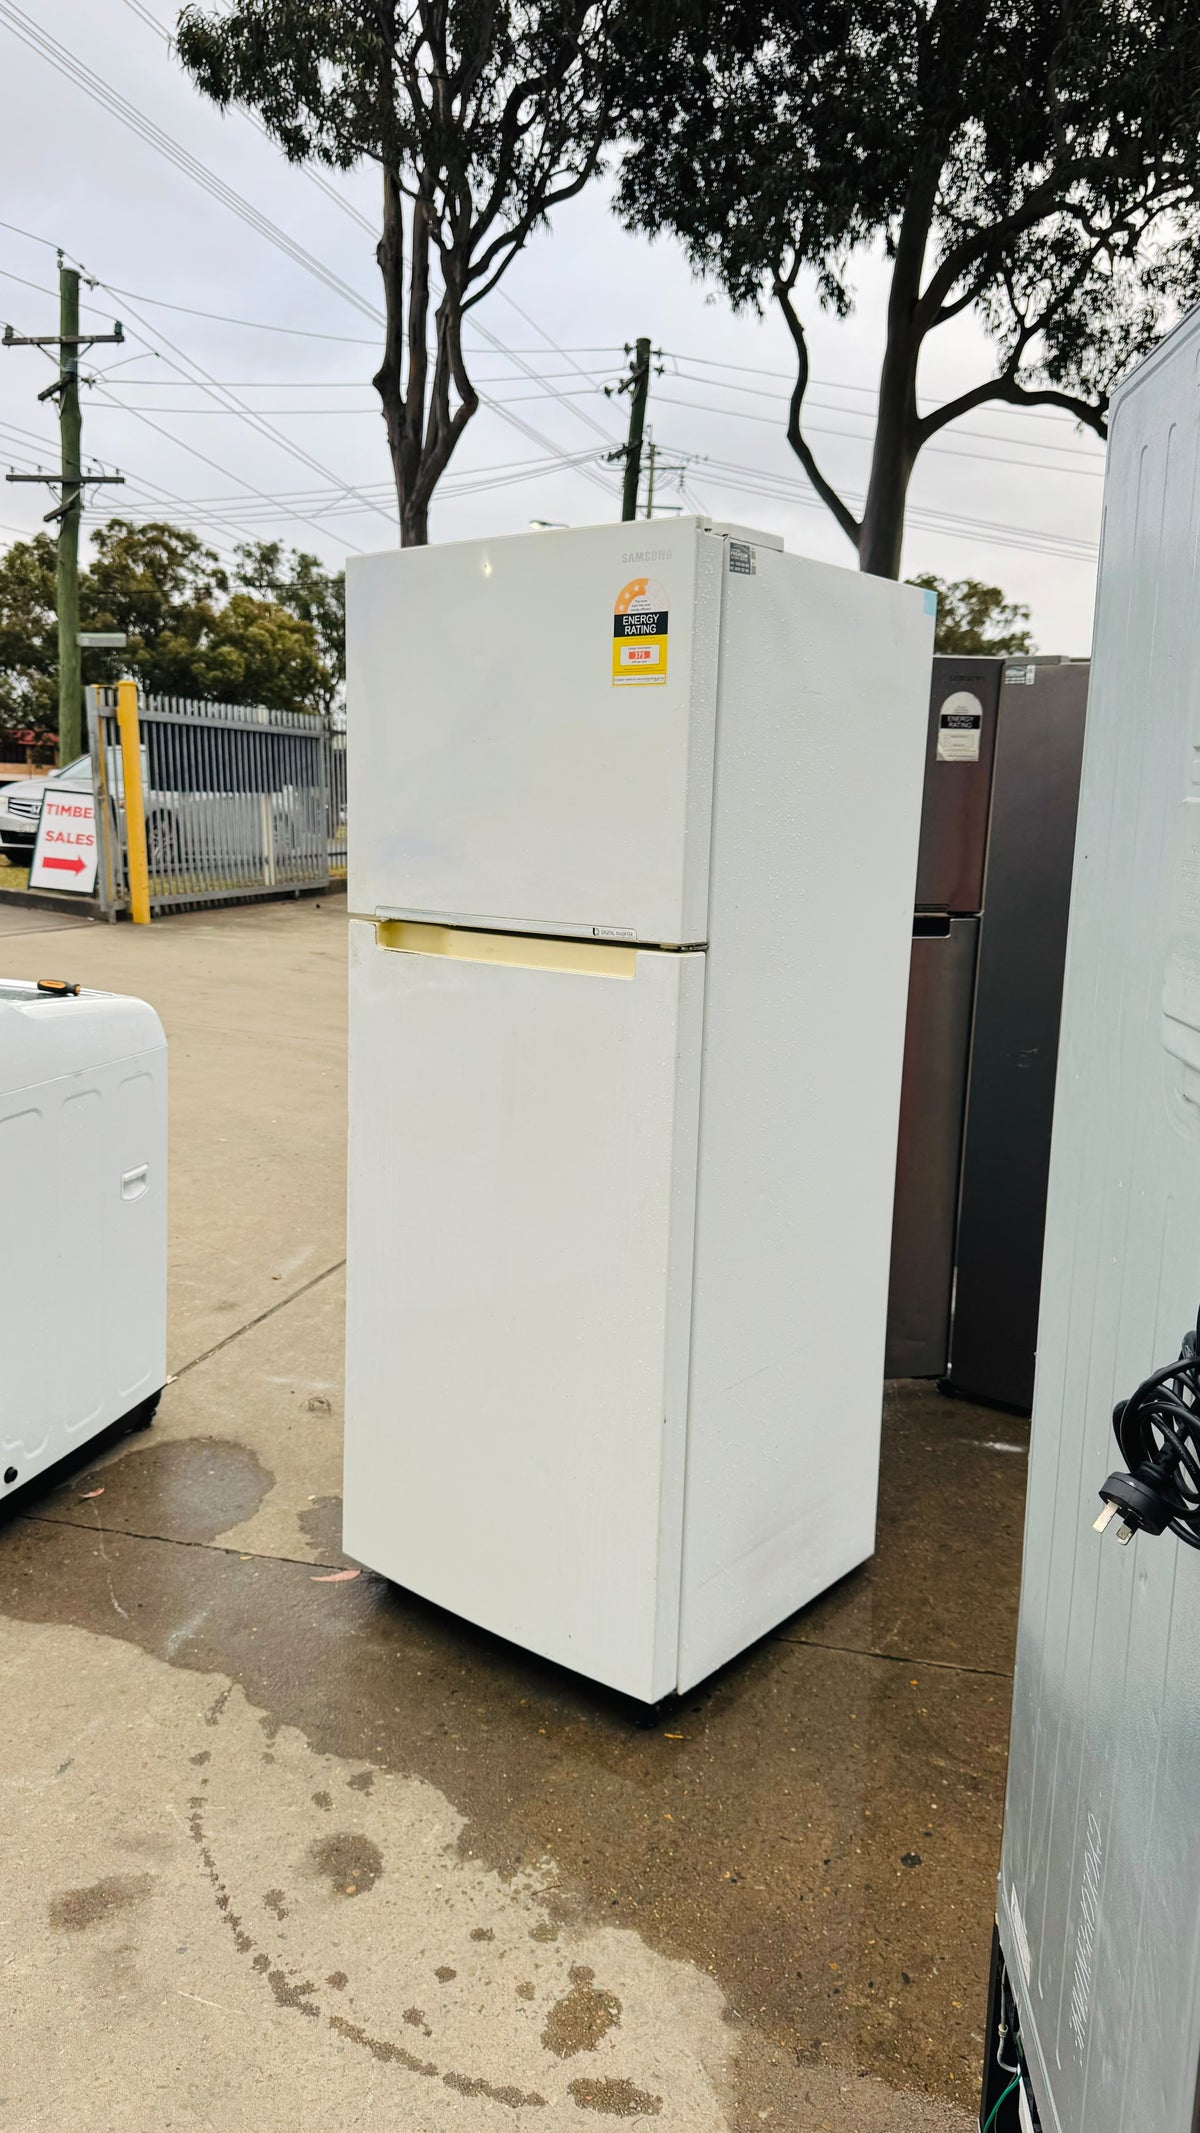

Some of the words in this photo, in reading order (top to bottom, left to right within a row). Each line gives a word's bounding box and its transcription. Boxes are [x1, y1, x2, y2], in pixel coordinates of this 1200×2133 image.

[621, 549, 673, 564] SAMSUNG
[622, 613, 660, 626] ENERGY
[624, 624, 657, 635] RATING
[46, 803, 95, 819] TIMBE
[45, 830, 95, 846] SALES
